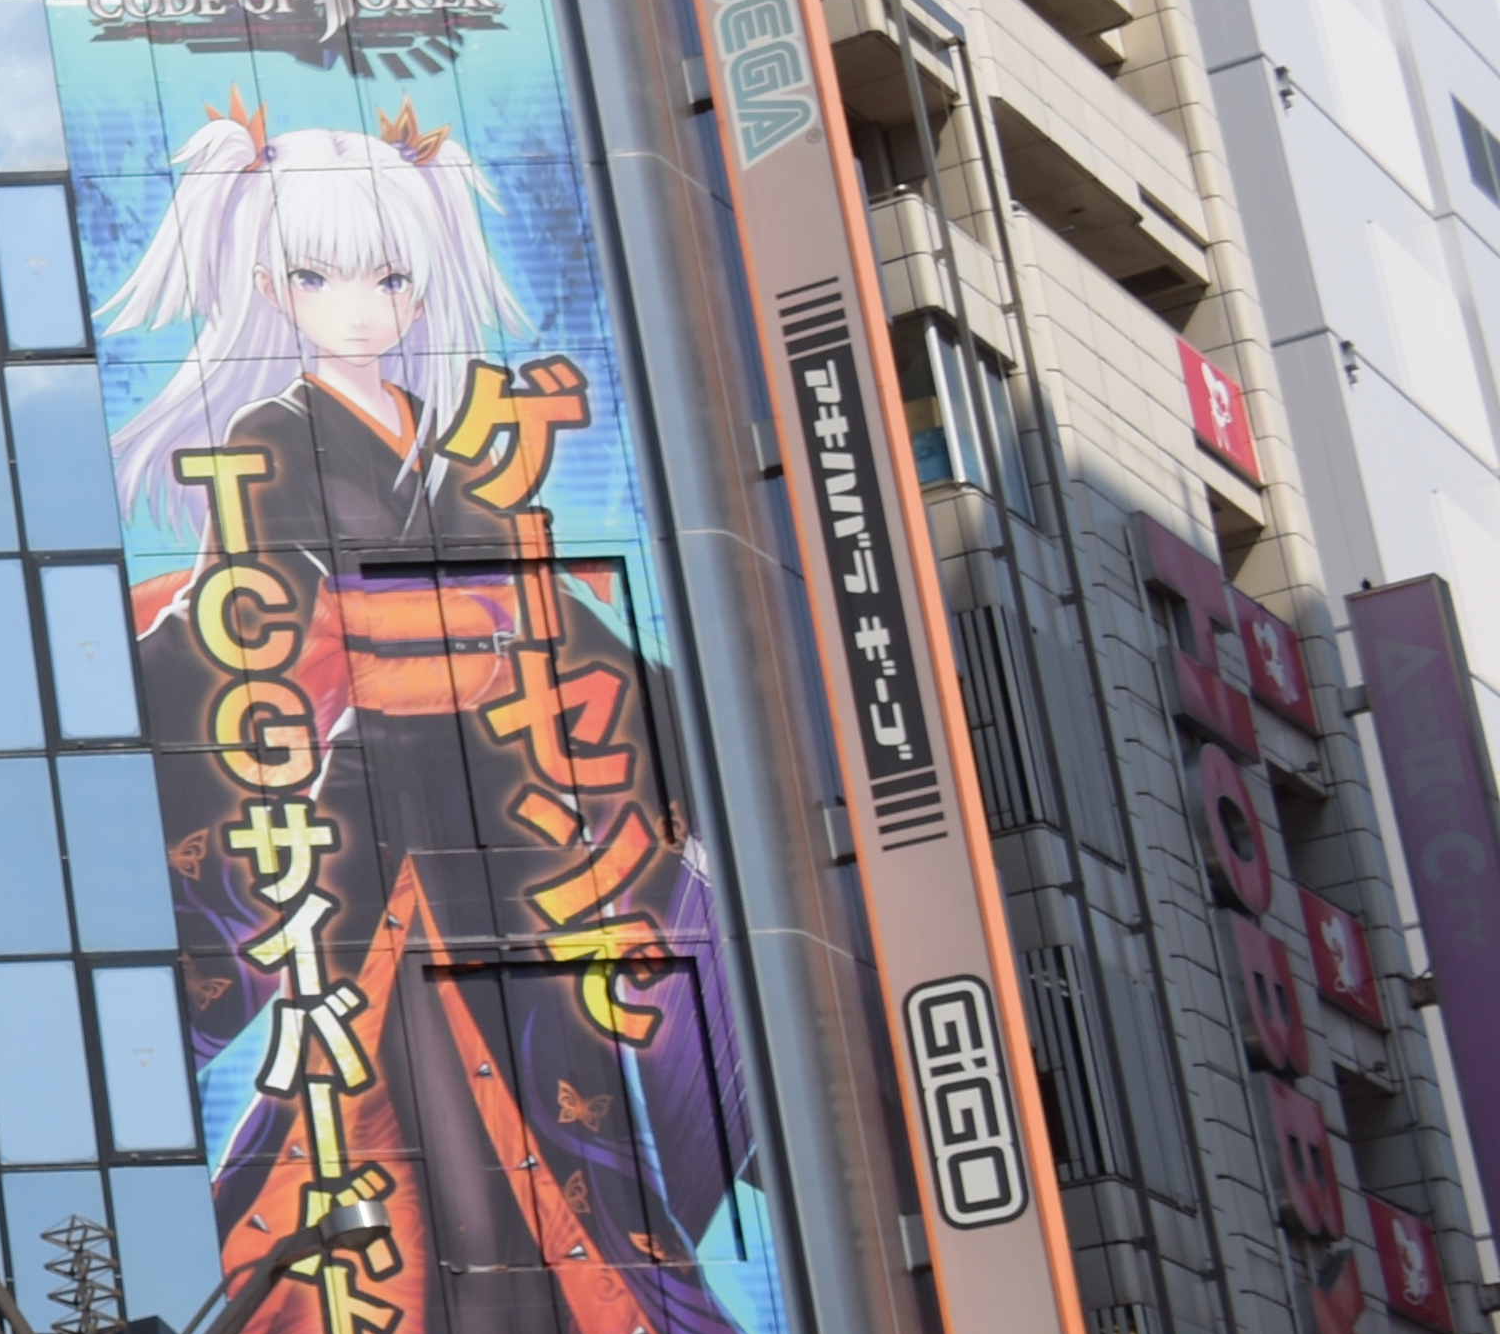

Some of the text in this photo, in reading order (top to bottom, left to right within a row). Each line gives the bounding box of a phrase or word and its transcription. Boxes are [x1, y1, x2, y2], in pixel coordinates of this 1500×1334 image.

[803, 359, 879, 595] アキハバラ
[444, 357, 667, 1047] ゲーセンで
[902, 972, 1030, 1235] GiGO
